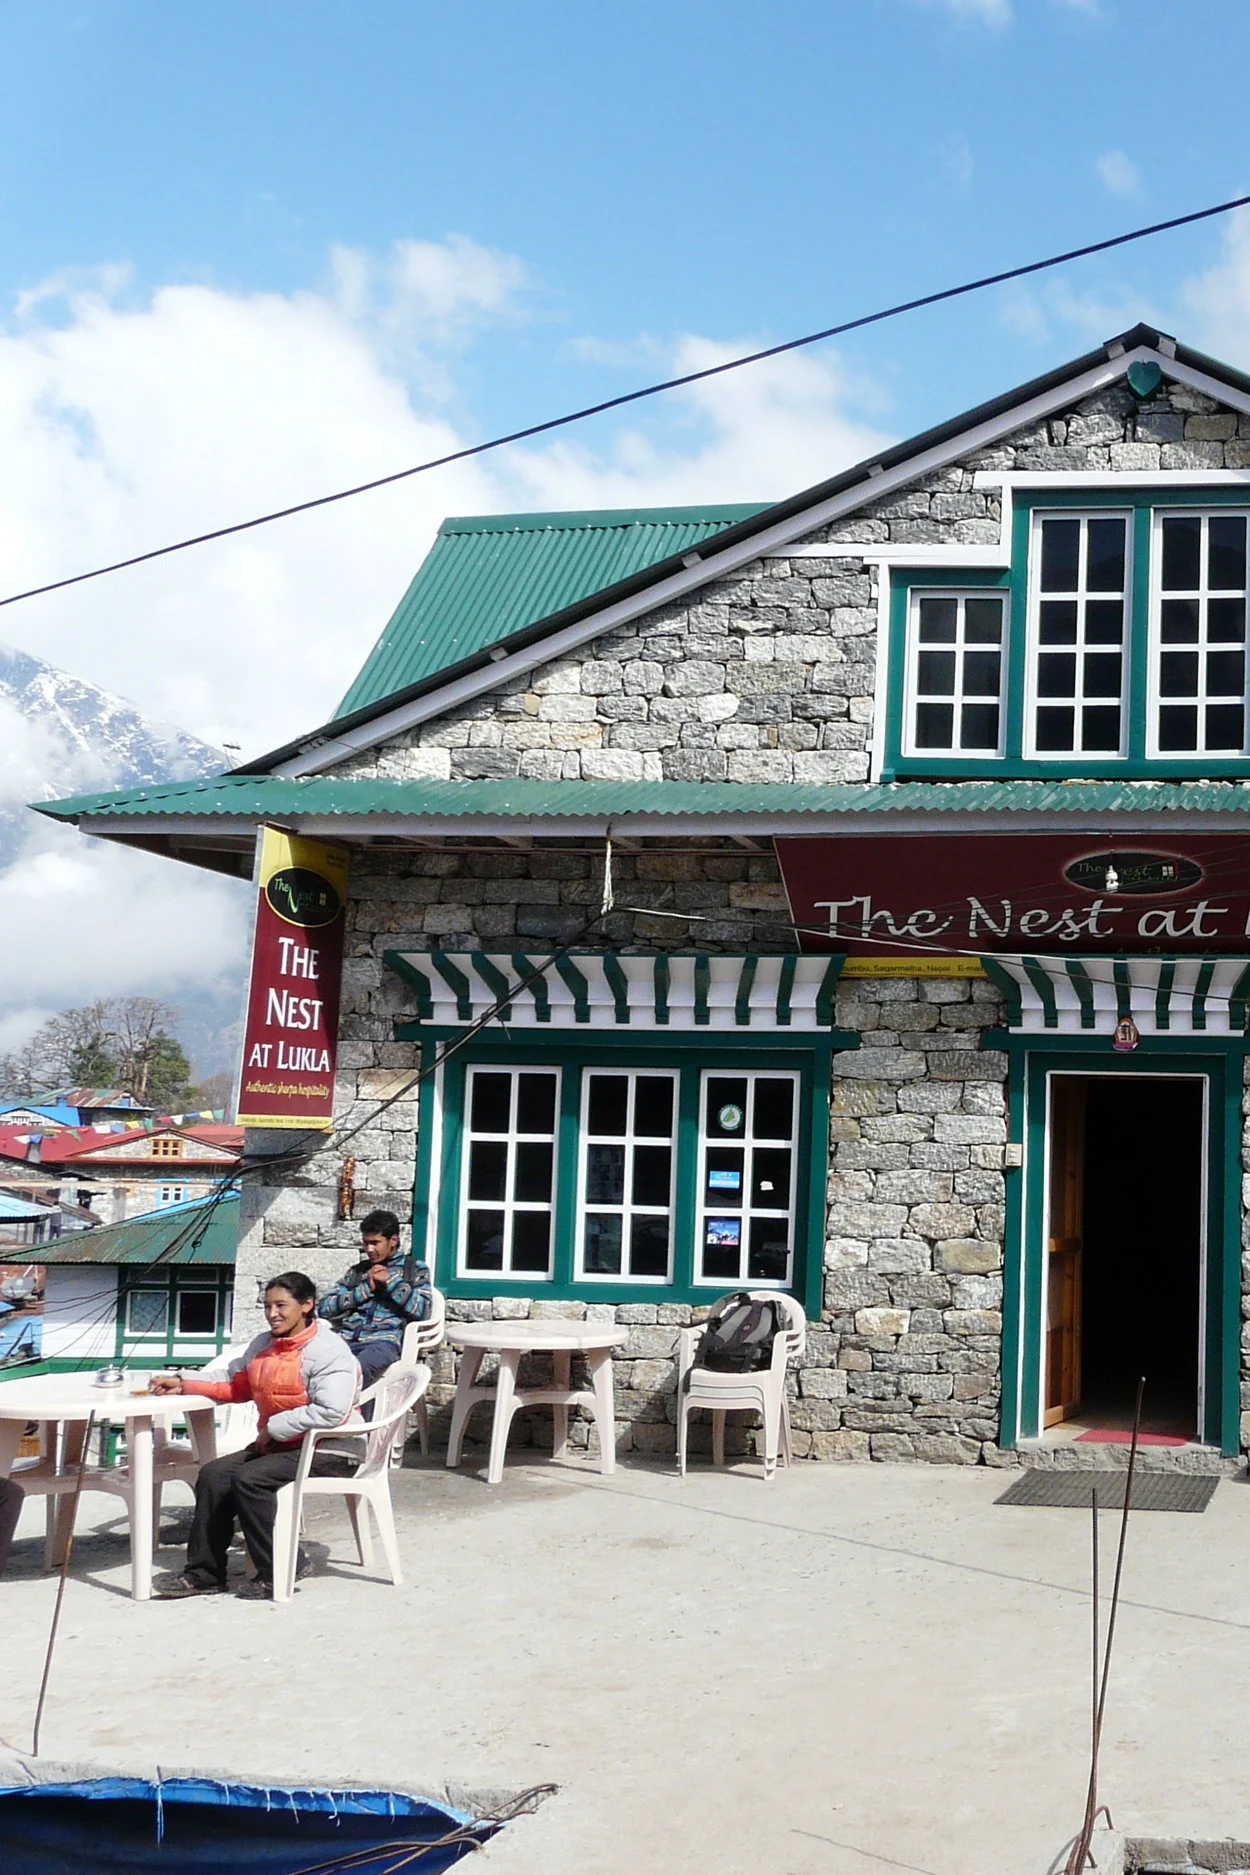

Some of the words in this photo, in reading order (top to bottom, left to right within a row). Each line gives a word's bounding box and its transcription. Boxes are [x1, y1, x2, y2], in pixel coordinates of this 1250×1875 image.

[274, 878, 290, 893] The
[813, 896, 954, 938] The
[966, 897, 1124, 941] Nest
[1137, 900, 1229, 938] at
[278, 936, 320, 980] THE
[926, 964, 951, 974] Nepal
[265, 987, 325, 1031] NEST
[248, 1043, 273, 1068] AT
[276, 1040, 331, 1073] LUKLA
